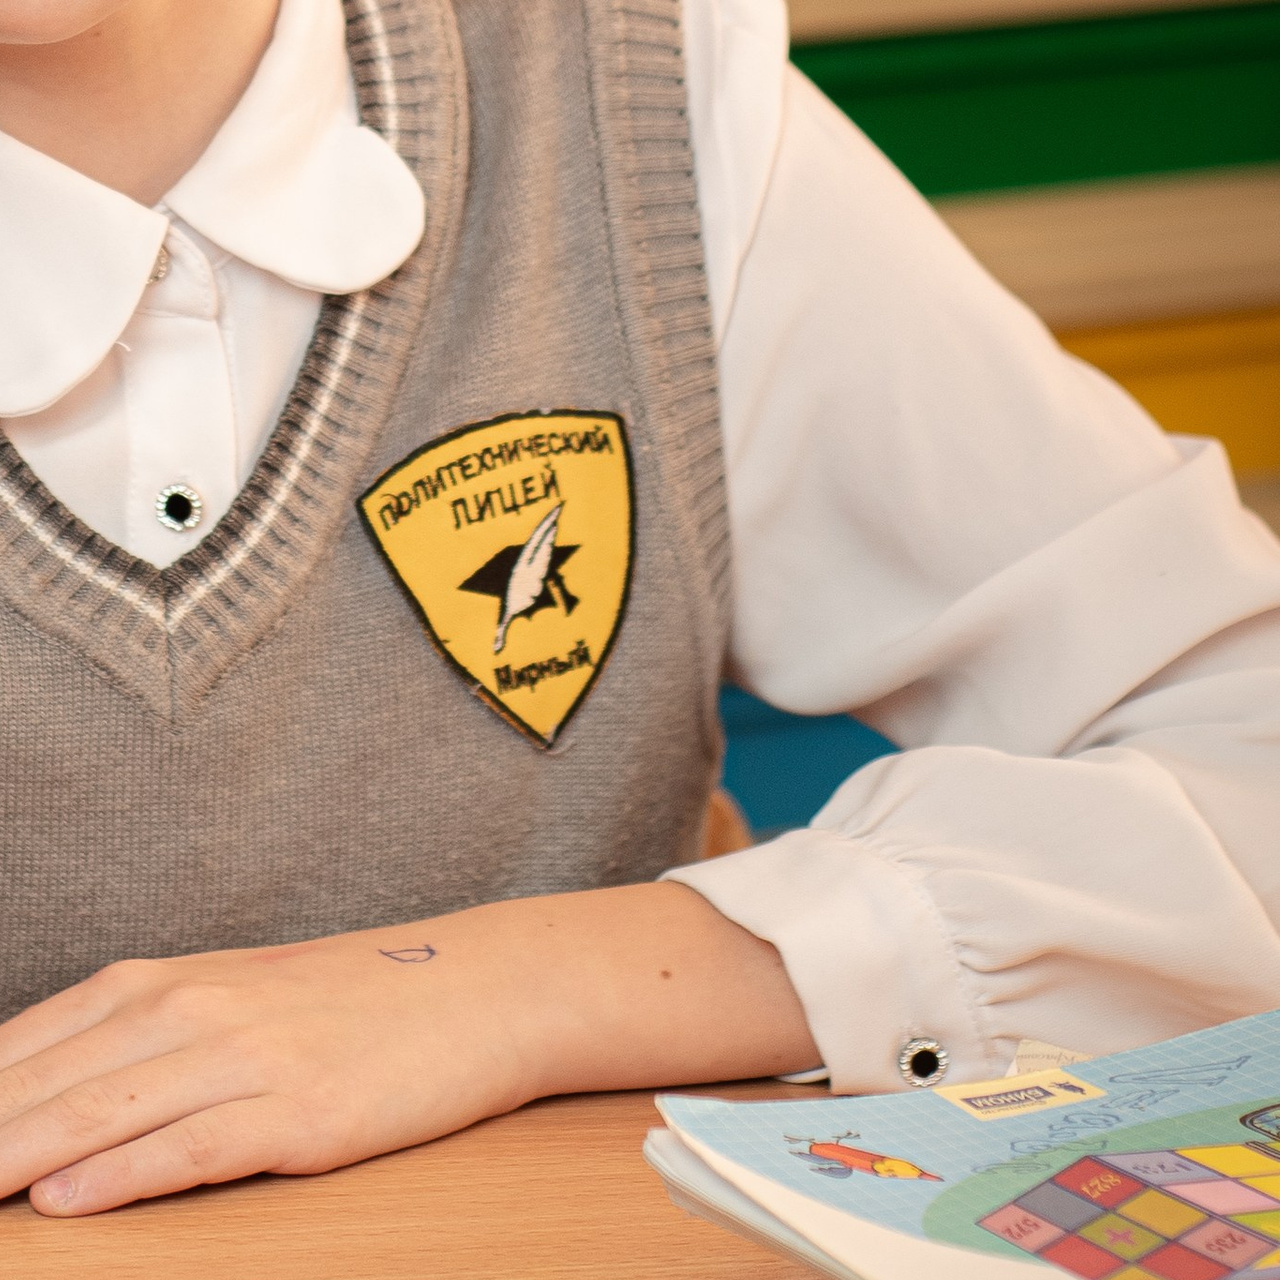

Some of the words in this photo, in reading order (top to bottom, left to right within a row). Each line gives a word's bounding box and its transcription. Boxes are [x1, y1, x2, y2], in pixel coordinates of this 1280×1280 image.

[378, 425, 614, 531] ПОЛИТЕХНИЧЕСКИЙ
[450, 462, 562, 530] ЛИЦЕЙ
[493, 639, 595, 695] Мирный
[1081, 1174, 1122, 1199] 827
[1002, 1219, 1041, 1240] 572
[1205, 1232, 1246, 1254] 235
